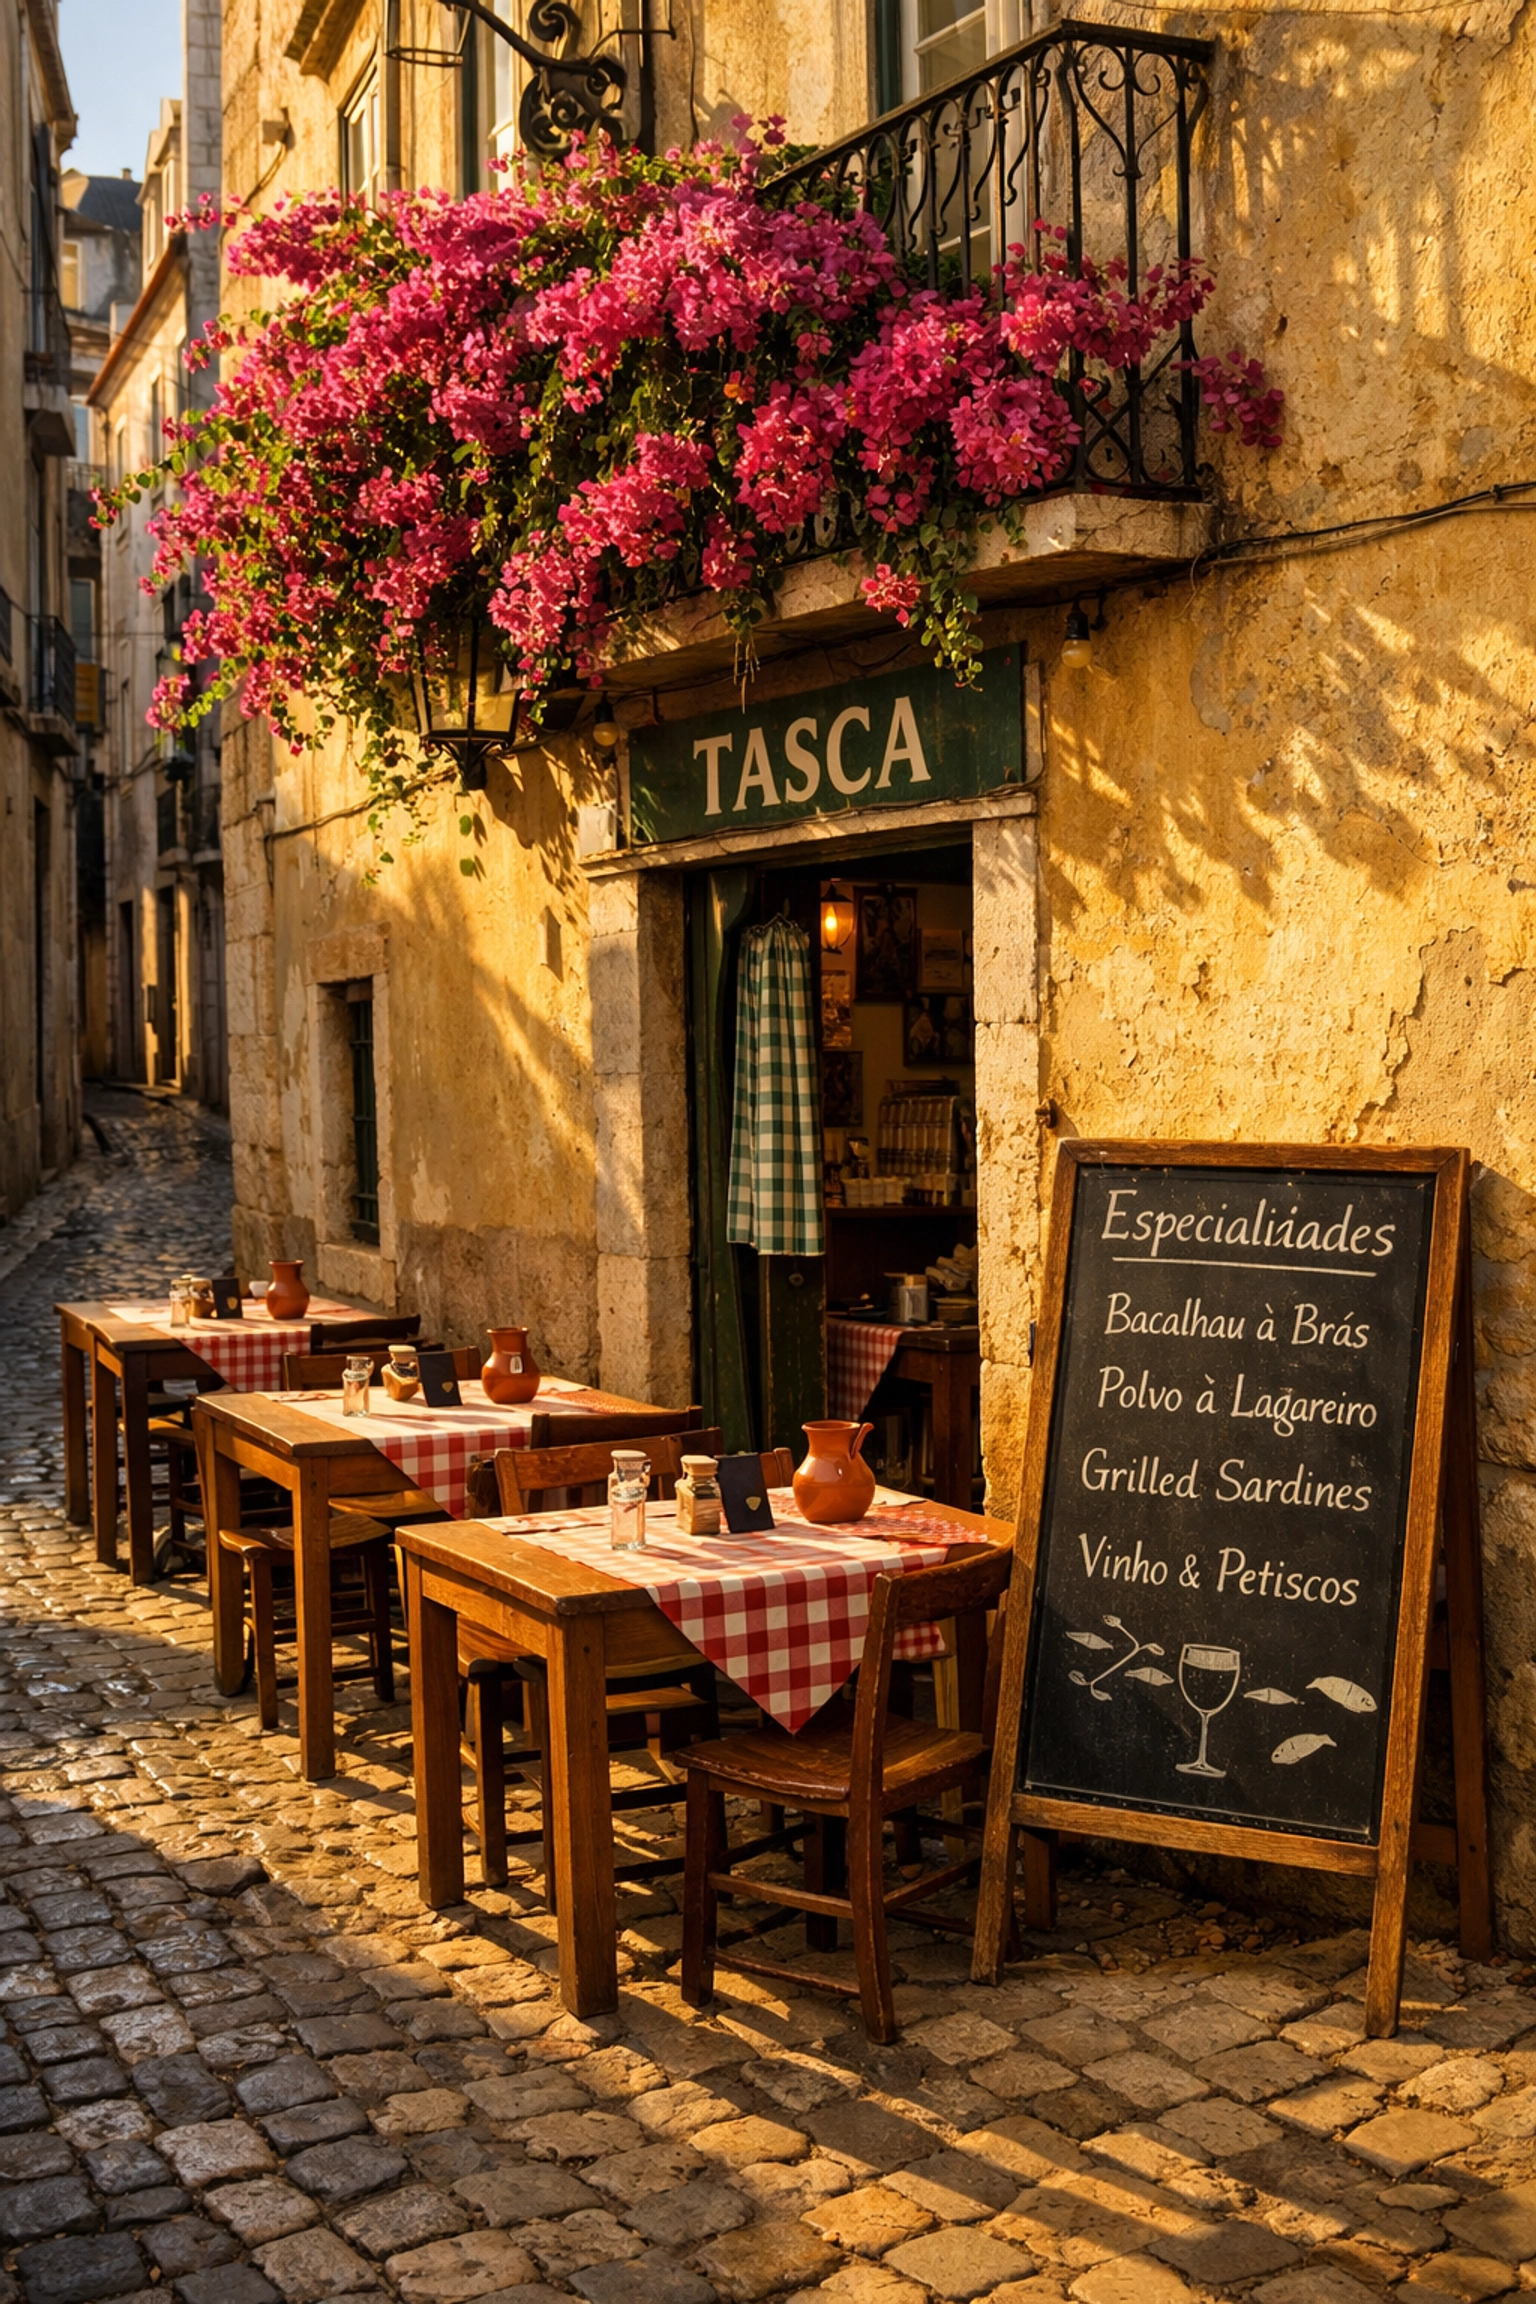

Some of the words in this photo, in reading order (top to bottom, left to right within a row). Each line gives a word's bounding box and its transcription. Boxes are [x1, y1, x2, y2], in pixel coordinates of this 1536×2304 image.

[693, 696, 932, 817] TASCA
[1104, 1292, 1246, 1340] Bacalhau
[1256, 1303, 1277, 1342] à
[1291, 1303, 1370, 1349] Brás
[1097, 1365, 1183, 1412] Polvo
[1195, 1373, 1218, 1414] à
[1230, 1373, 1378, 1437] Lagareiro
[1081, 1447, 1200, 1499] Grilled
[1215, 1458, 1373, 1512] Sardines
[1078, 1533, 1168, 1586] Vinho
[1178, 1553, 1201, 1589] &
[1216, 1547, 1360, 1606] Petiscos
